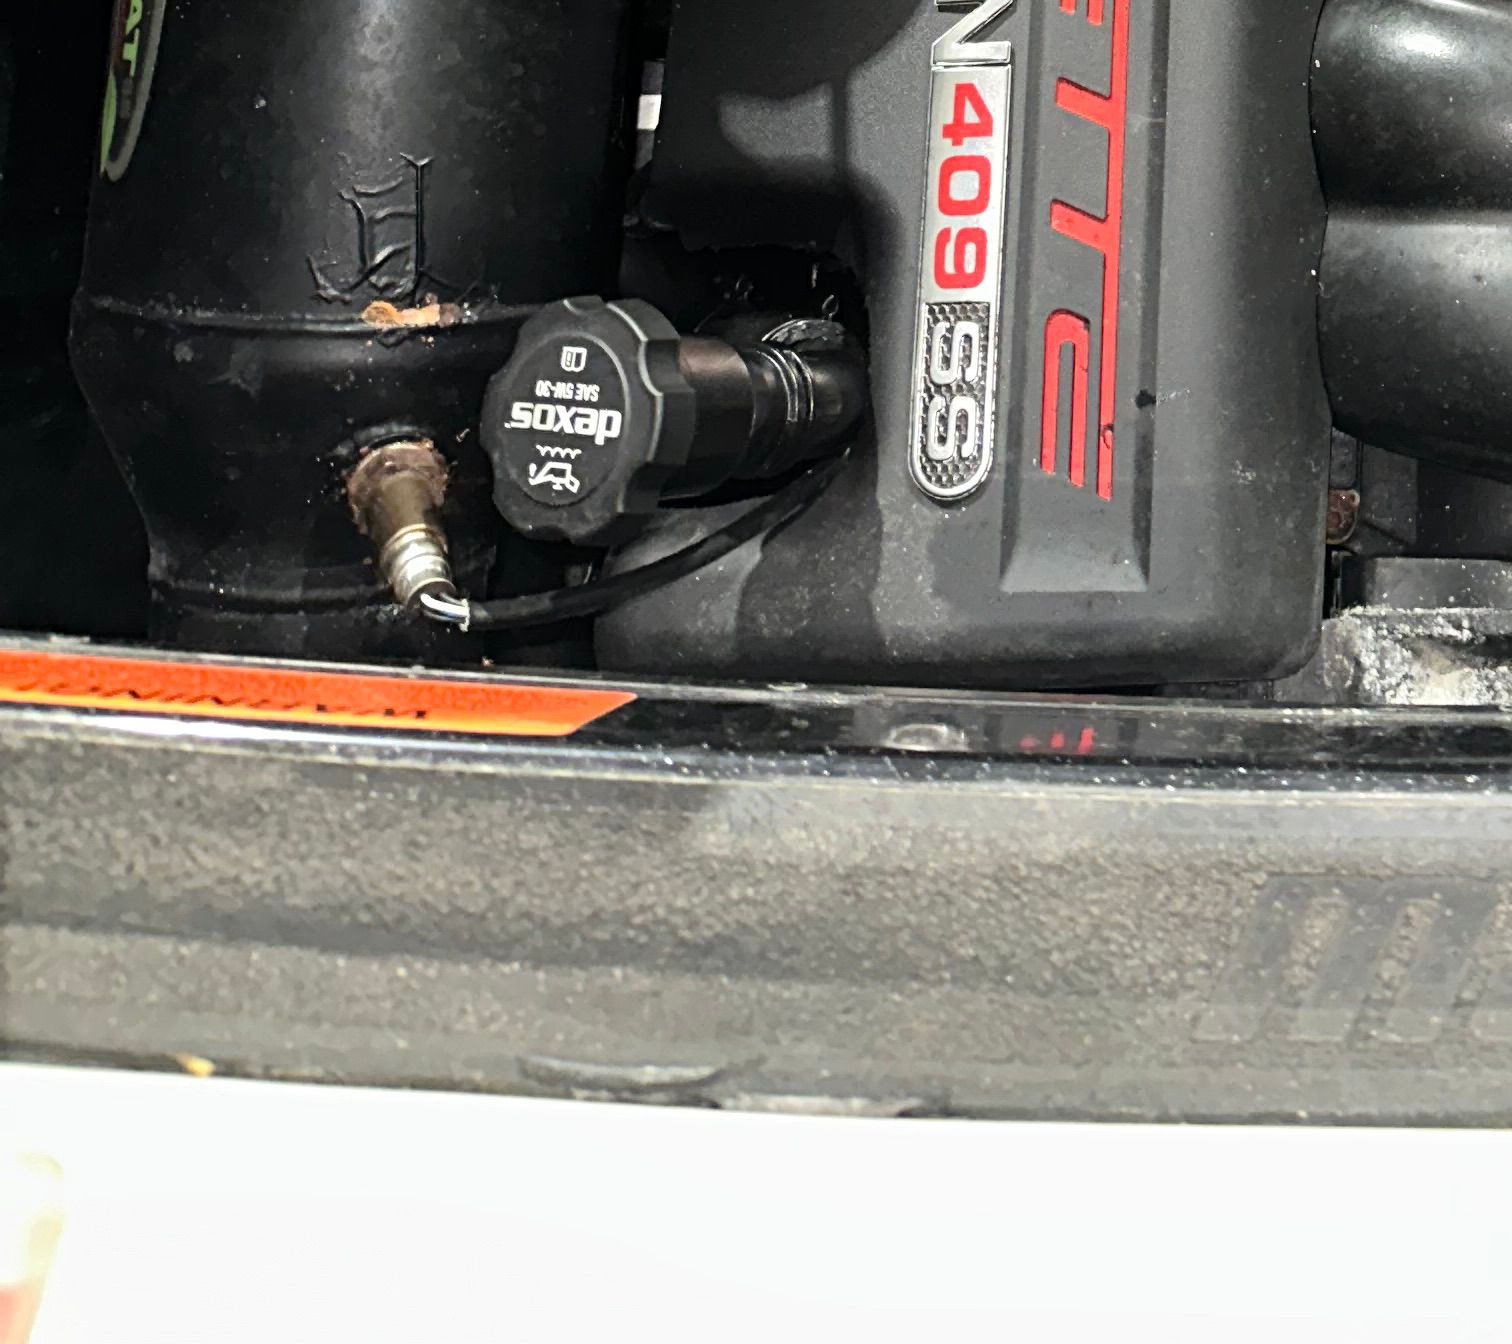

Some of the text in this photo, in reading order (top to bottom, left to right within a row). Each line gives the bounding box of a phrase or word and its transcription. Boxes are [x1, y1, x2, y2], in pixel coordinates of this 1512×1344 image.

[933, 82, 995, 290] 409
[508, 401, 623, 446] dexos
[534, 379, 600, 403] SAE 5W-30
[926, 320, 979, 462] SS
